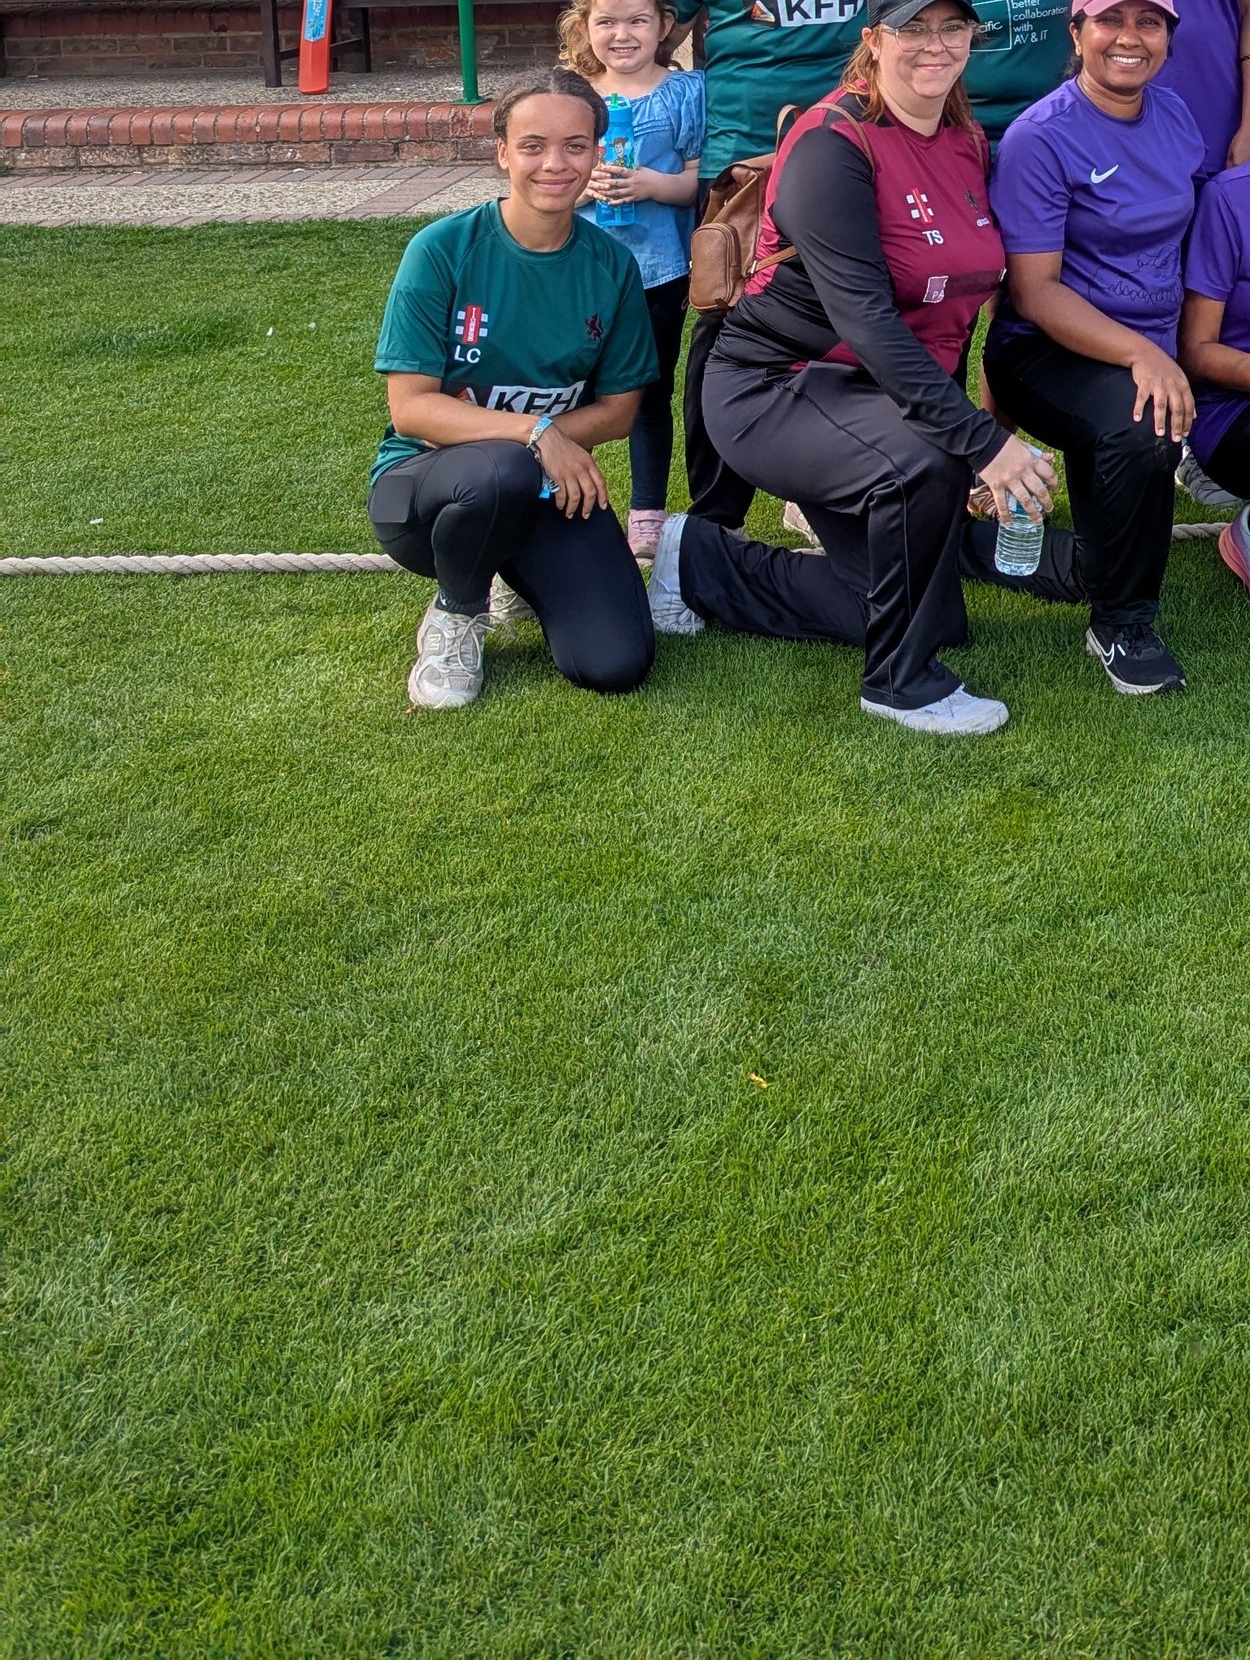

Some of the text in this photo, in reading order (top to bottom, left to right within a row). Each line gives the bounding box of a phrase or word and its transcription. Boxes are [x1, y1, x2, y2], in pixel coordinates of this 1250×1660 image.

[1013, 6, 1069, 21] collaboration
[1012, 21, 1034, 33] with
[1013, 29, 1049, 46] AV & IT
[922, 229, 944, 246] TS
[454, 345, 481, 364] LC
[494, 385, 582, 415] KFH
